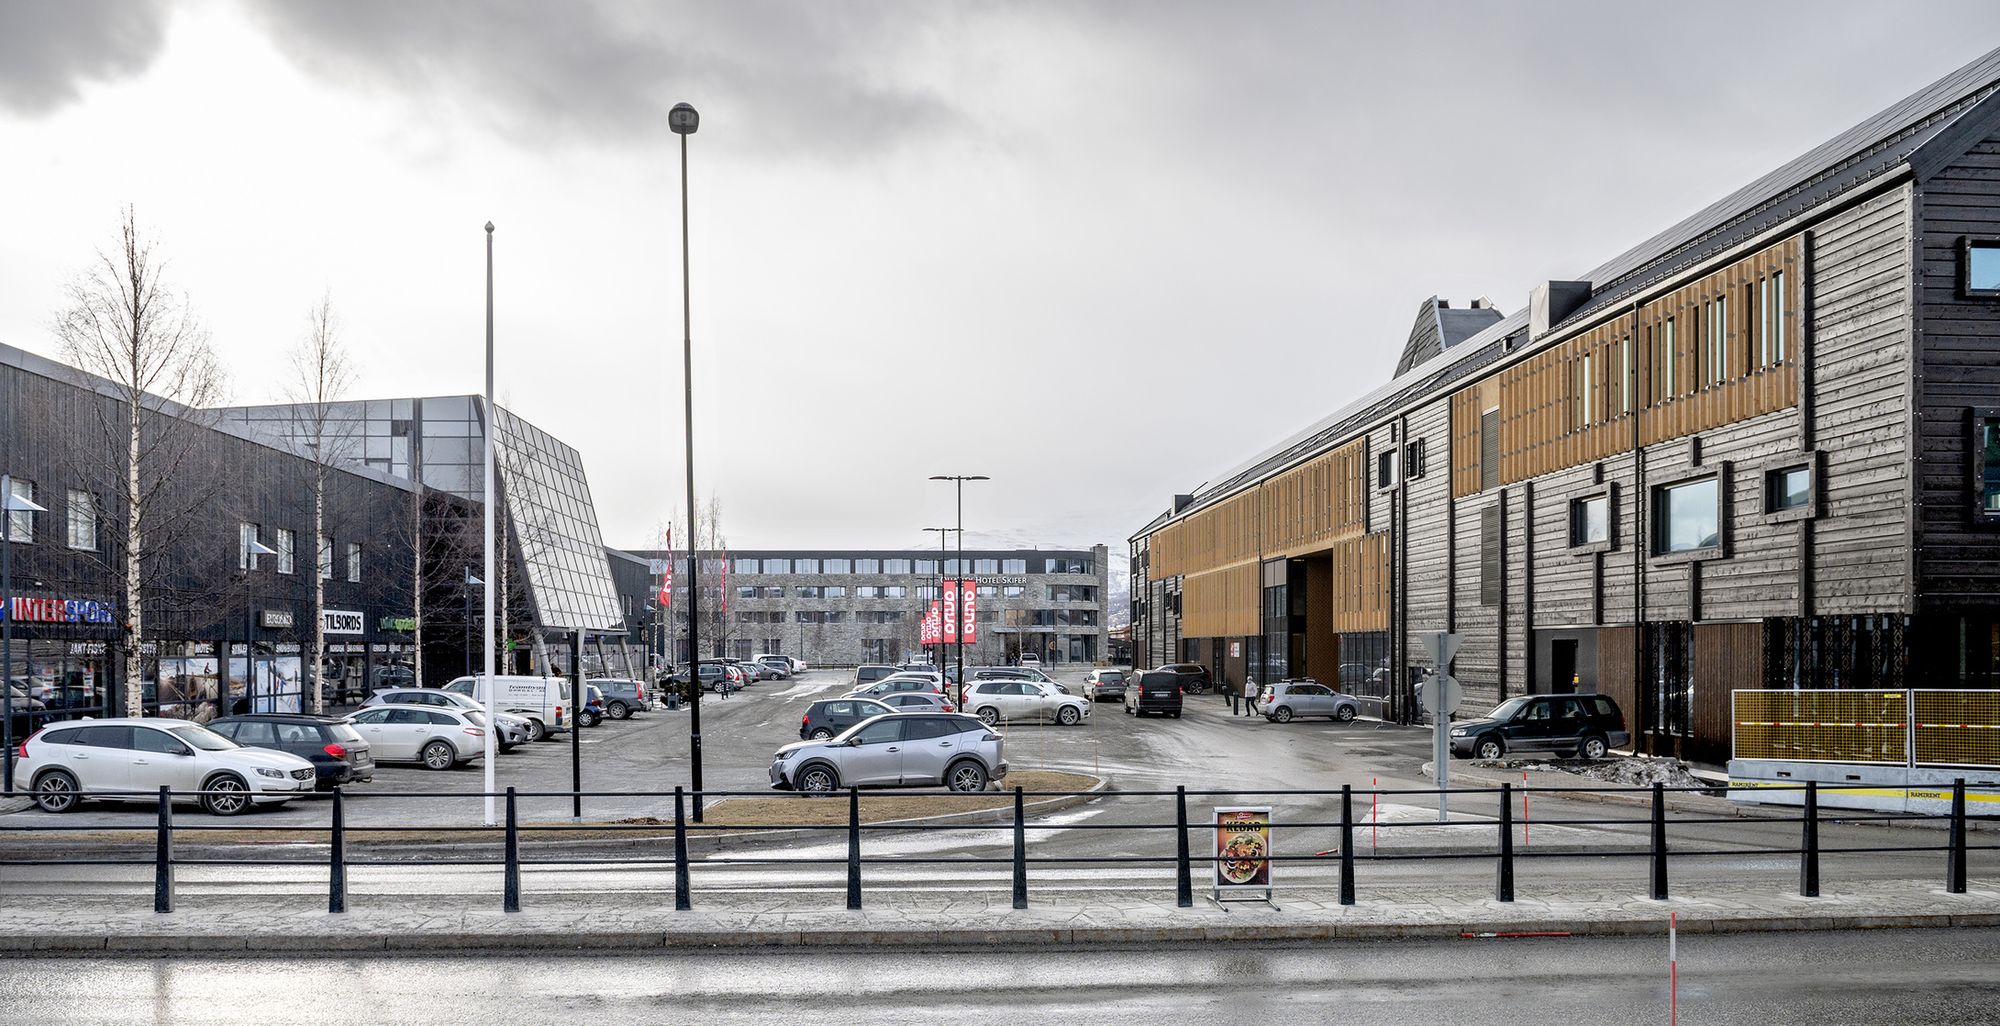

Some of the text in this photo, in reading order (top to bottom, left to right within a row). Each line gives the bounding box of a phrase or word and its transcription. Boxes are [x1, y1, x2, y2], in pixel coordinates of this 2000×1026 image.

[975, 576, 1000, 584] HOTEL
[1002, 576, 1027, 584] SKIFER
[325, 614, 361, 630] TILBORDS
[1226, 821, 1261, 832] KEBAB
